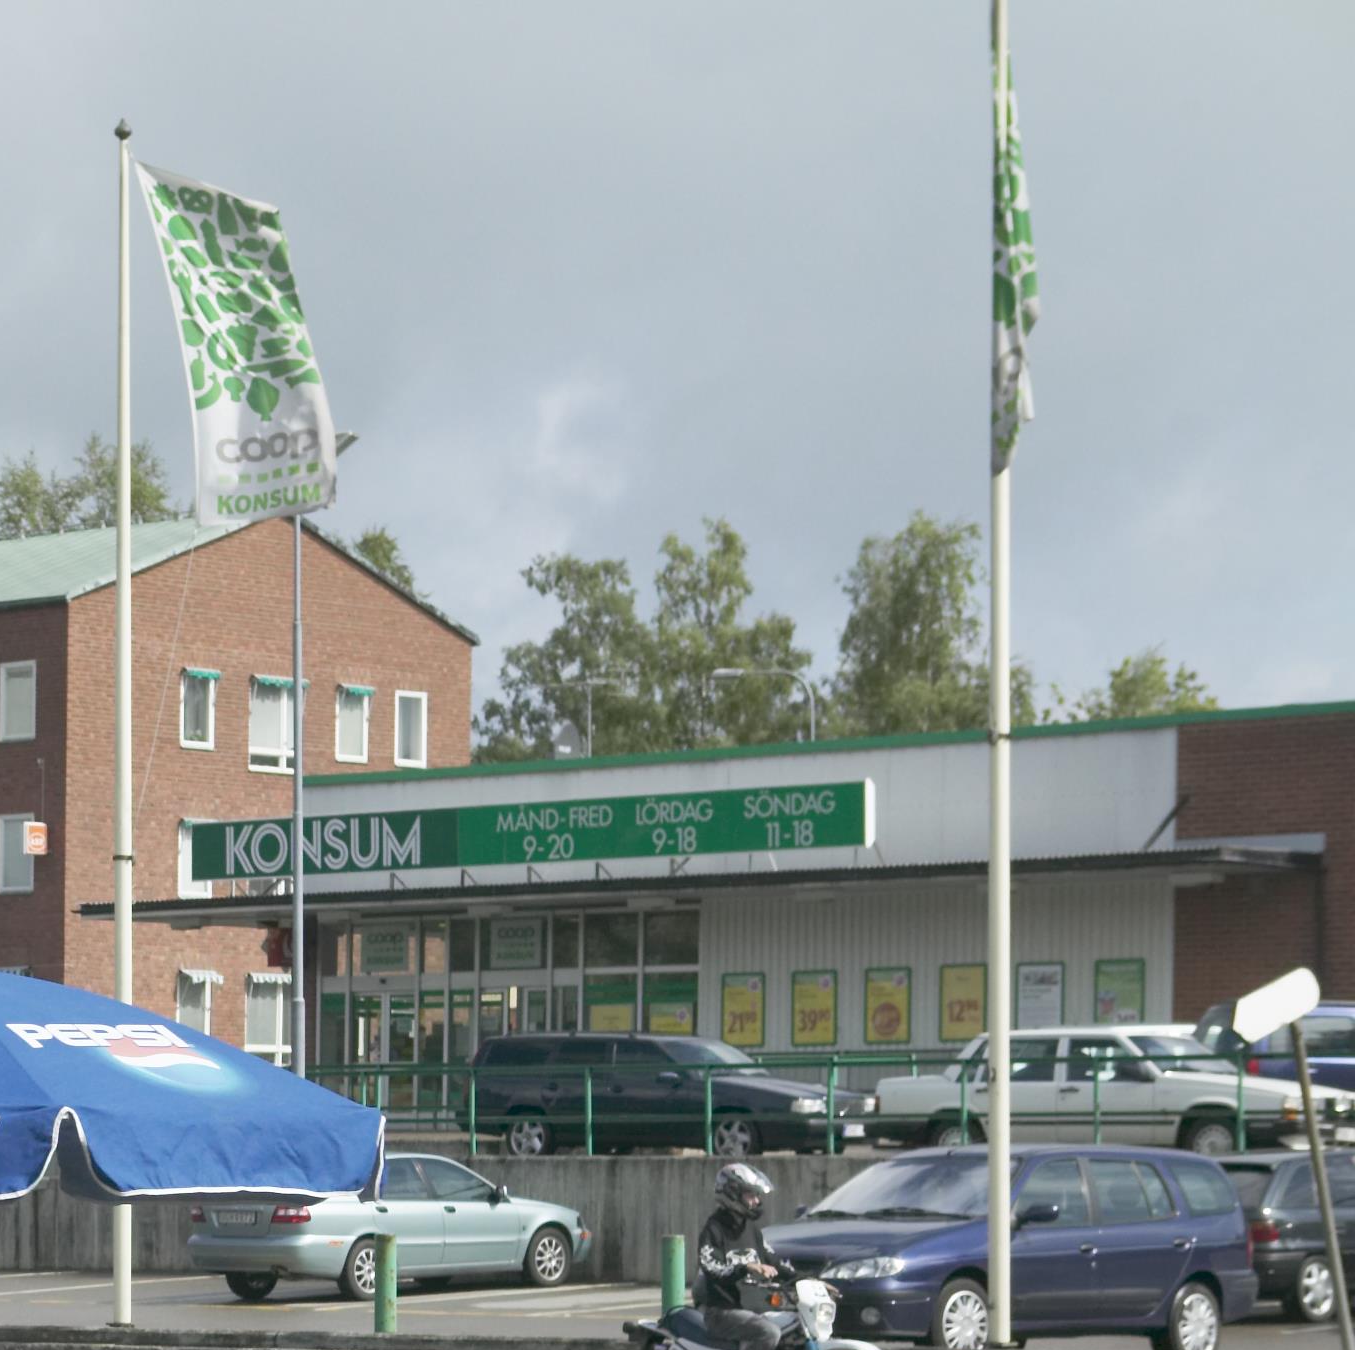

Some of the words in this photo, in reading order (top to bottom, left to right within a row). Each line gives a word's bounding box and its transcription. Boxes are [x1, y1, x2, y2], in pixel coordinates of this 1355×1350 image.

[217, 483, 321, 515] KONSUM
[635, 798, 713, 825] LÖRDAG
[744, 789, 836, 818] SÖNDAG
[225, 815, 421, 876] KONSUM
[522, 834, 574, 861] 9-20
[652, 827, 697, 853] 9-18
[766, 820, 814, 848] 11-18
[5, 1023, 193, 1049] PEPSI
